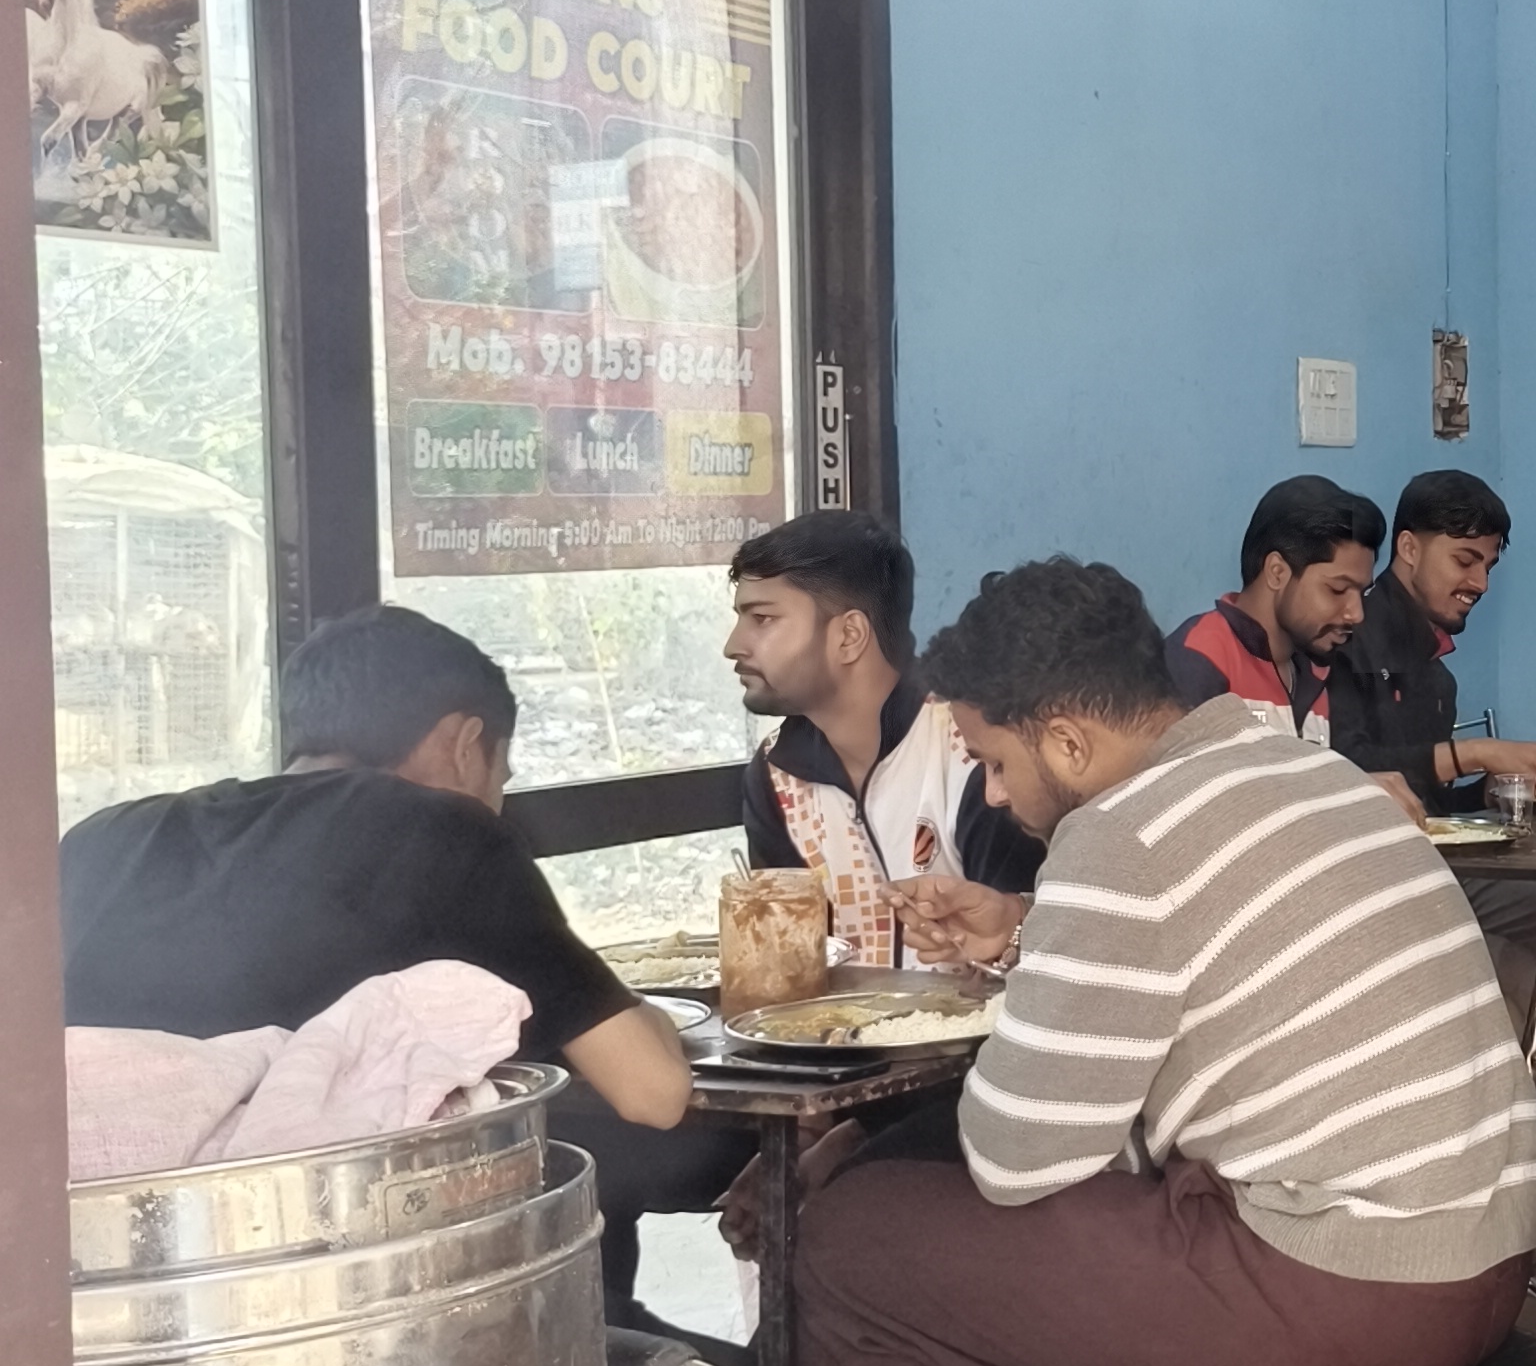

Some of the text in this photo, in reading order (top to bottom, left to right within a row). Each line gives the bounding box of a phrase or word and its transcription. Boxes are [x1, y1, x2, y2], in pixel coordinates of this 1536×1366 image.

[589, 32, 751, 120] COURT
[426, 324, 754, 387] Mob. 98153-83444
[414, 426, 539, 471] Breakfast
[575, 430, 640, 472] Lunch
[688, 432, 753, 477] Dinner
[822, 371, 841, 504] PUSH
[416, 516, 771, 556] Timing Morning 5:00 Am To Night 12:00 Pm
